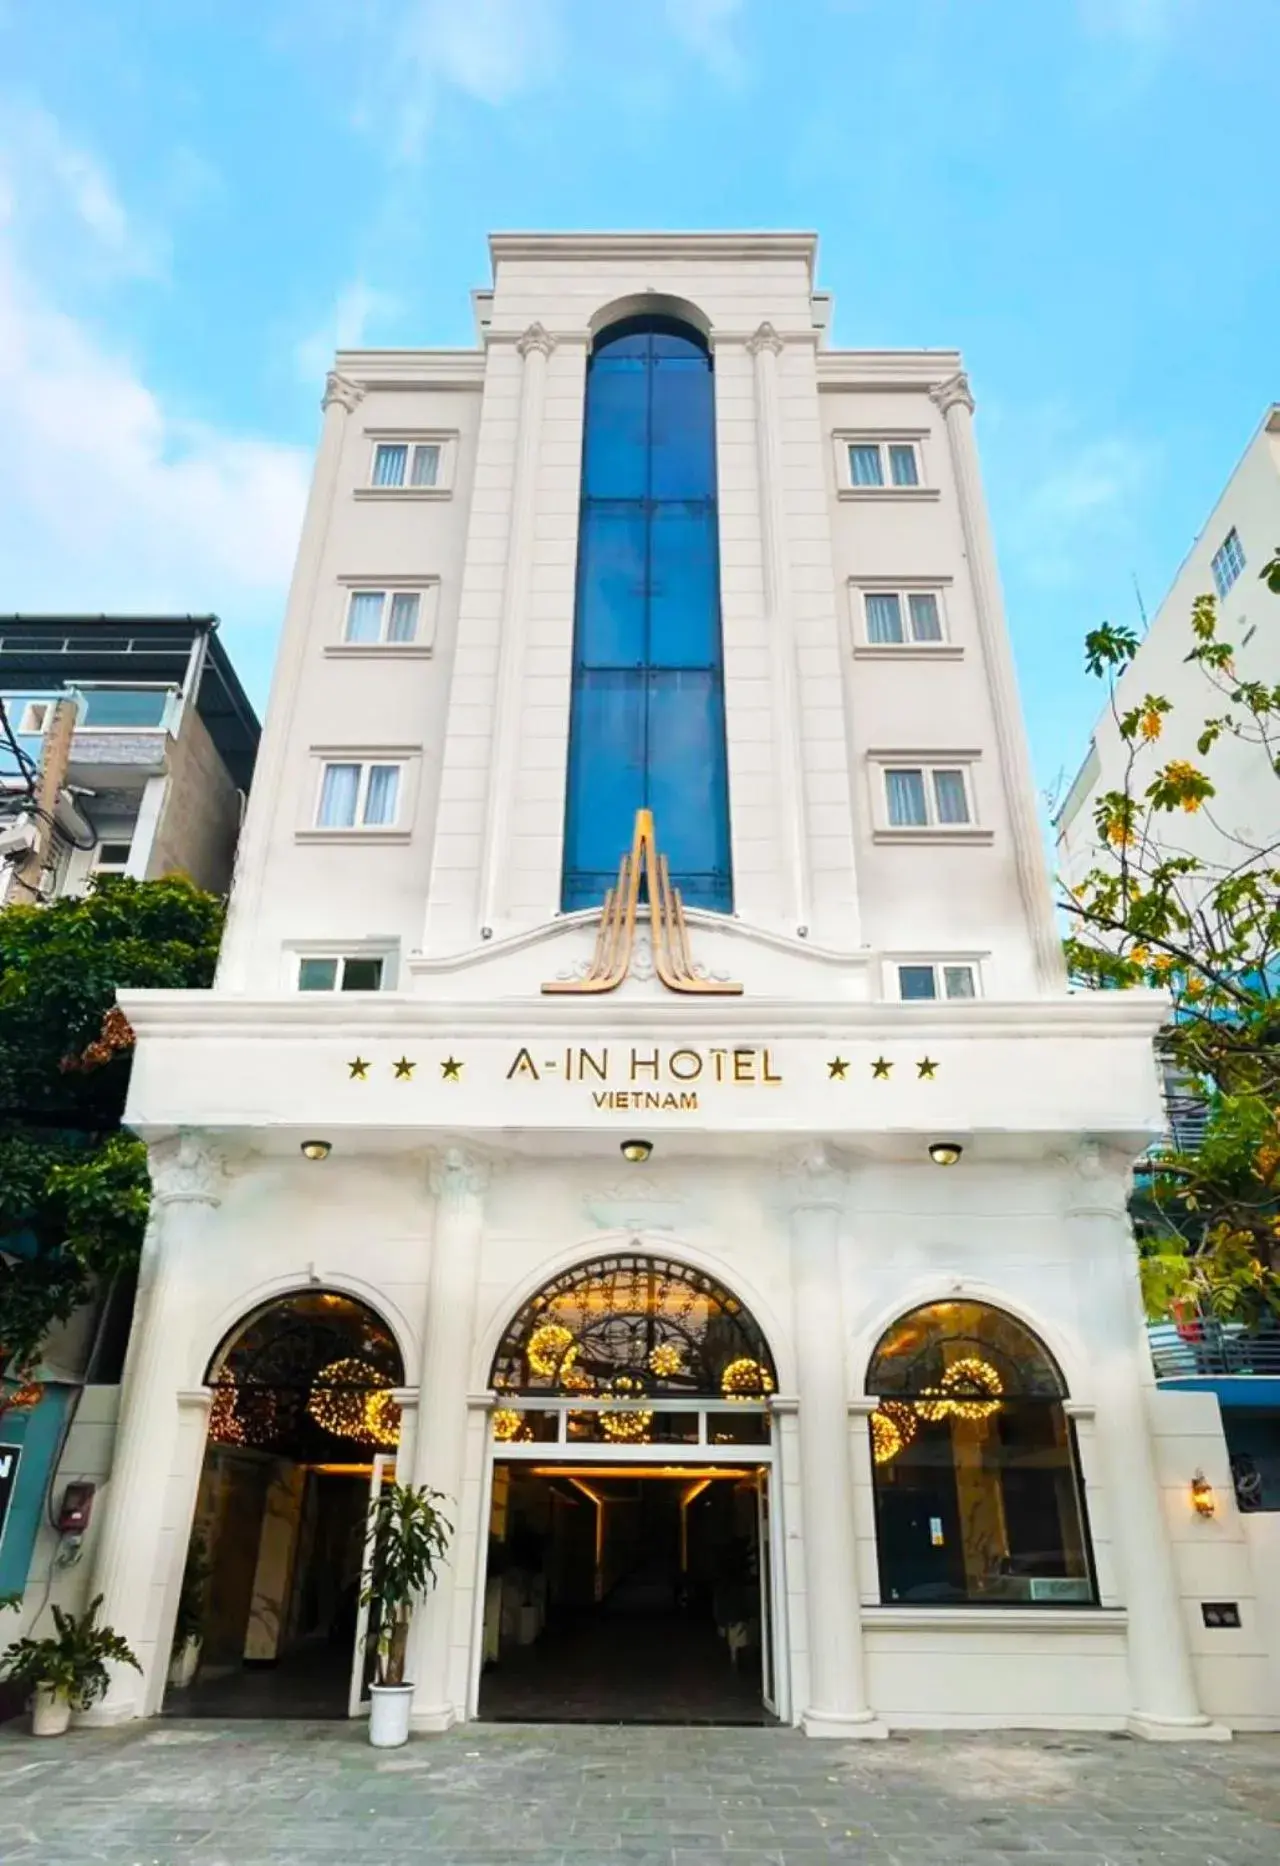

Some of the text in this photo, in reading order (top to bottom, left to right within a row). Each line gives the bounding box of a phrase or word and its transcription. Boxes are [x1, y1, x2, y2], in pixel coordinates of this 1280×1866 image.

[506, 1047, 783, 1082] A-IN HOTEL
[591, 1091, 698, 1109] VIETNAM
